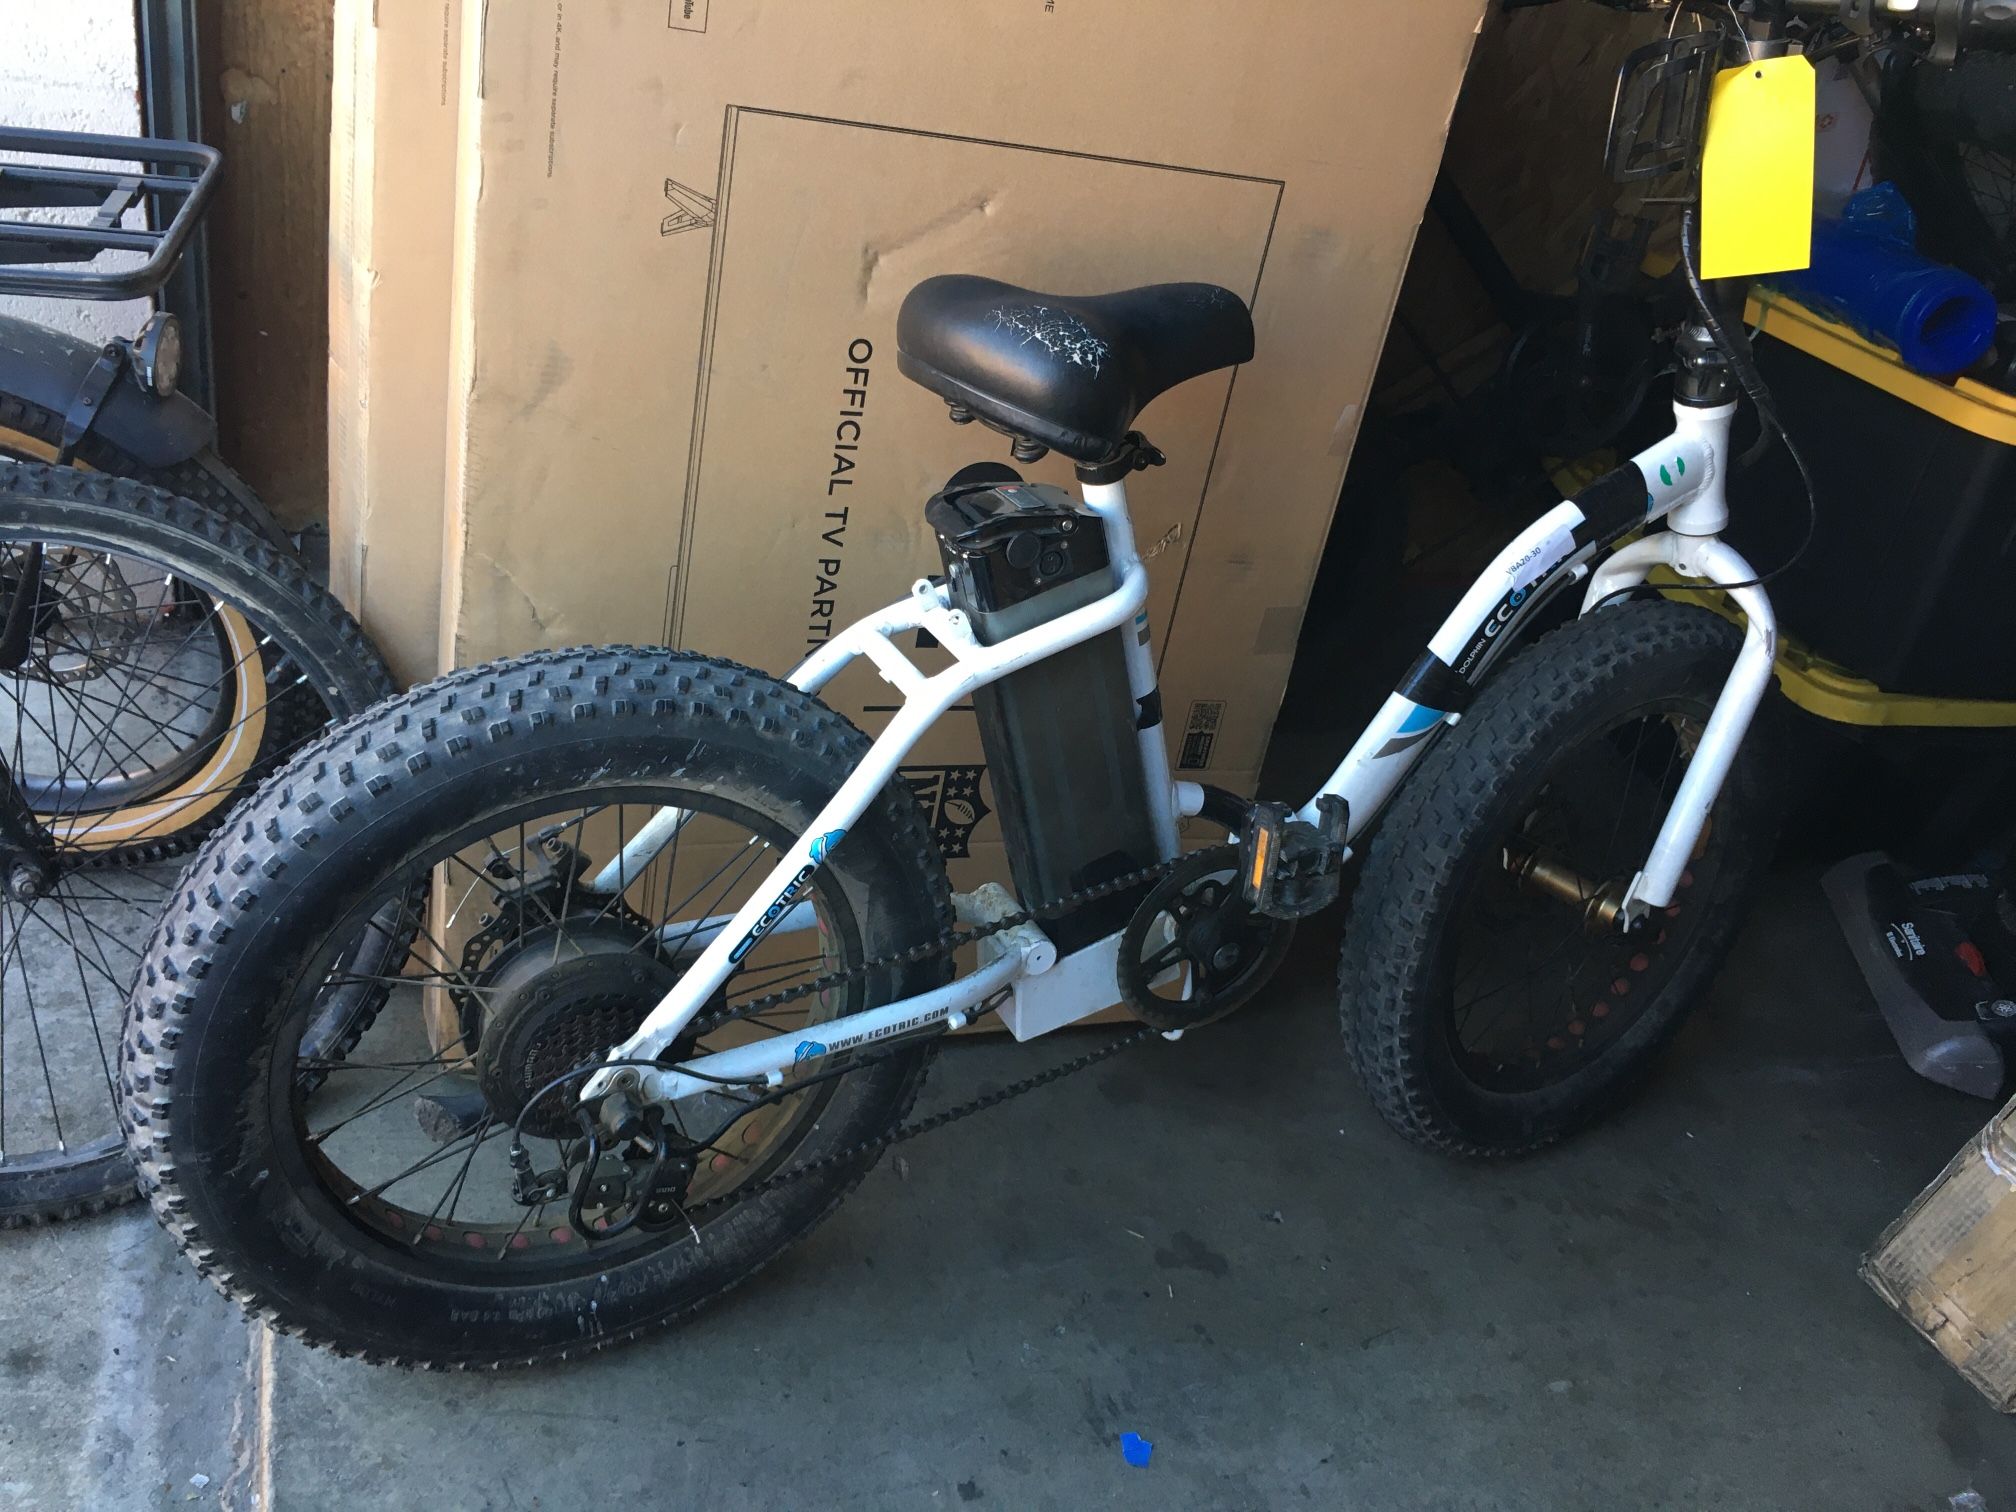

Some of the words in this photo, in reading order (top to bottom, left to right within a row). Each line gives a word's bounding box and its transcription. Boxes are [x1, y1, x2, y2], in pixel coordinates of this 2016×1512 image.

[552, 52, 560, 69] may
[553, 37, 561, 51] and
[551, 70, 559, 97] require
[549, 98, 557, 130] separate
[827, 338, 873, 496] OFFICIAL
[821, 506, 849, 548] TV
[1458, 637, 1487, 674] DOLPHIN
[828, 1005, 950, 1052] WWW.ECOTRIC.COM
